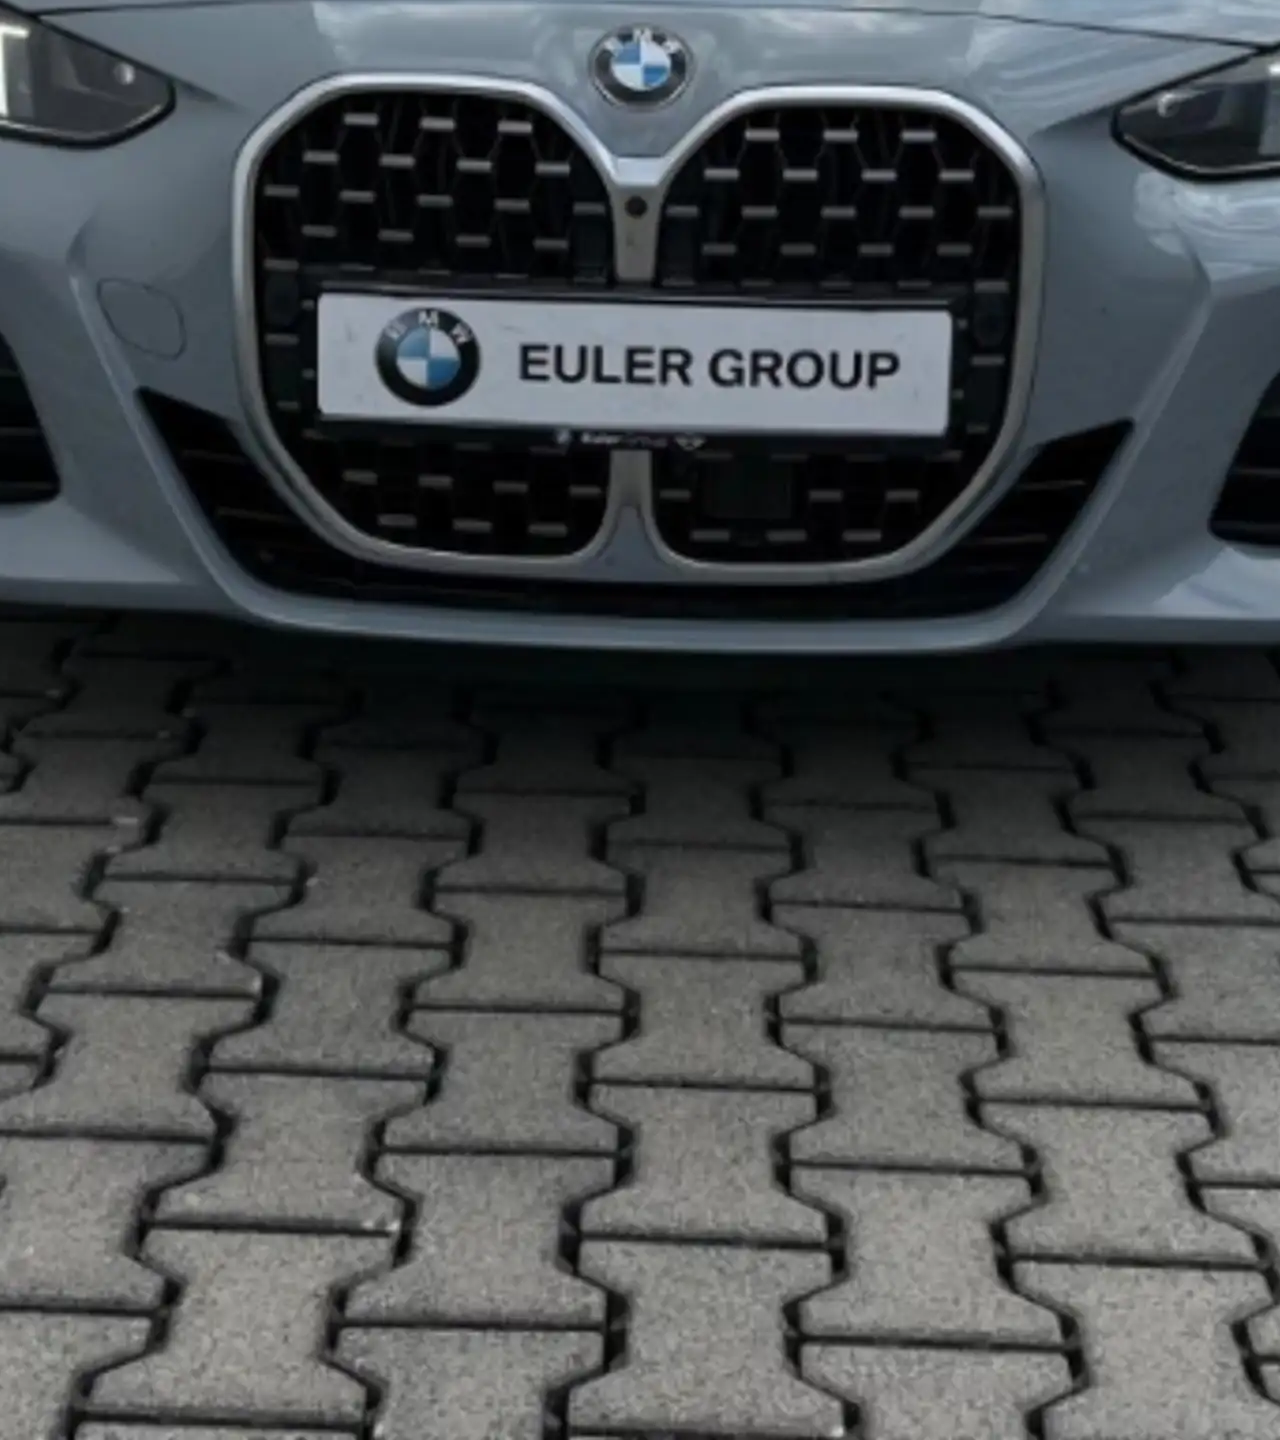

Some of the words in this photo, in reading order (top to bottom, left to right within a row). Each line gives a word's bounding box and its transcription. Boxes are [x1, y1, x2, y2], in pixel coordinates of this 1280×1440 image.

[603, 27, 682, 58] BMW
[383, 309, 474, 344] BMW
[518, 343, 693, 387] EULER
[708, 348, 901, 390] GROUP
